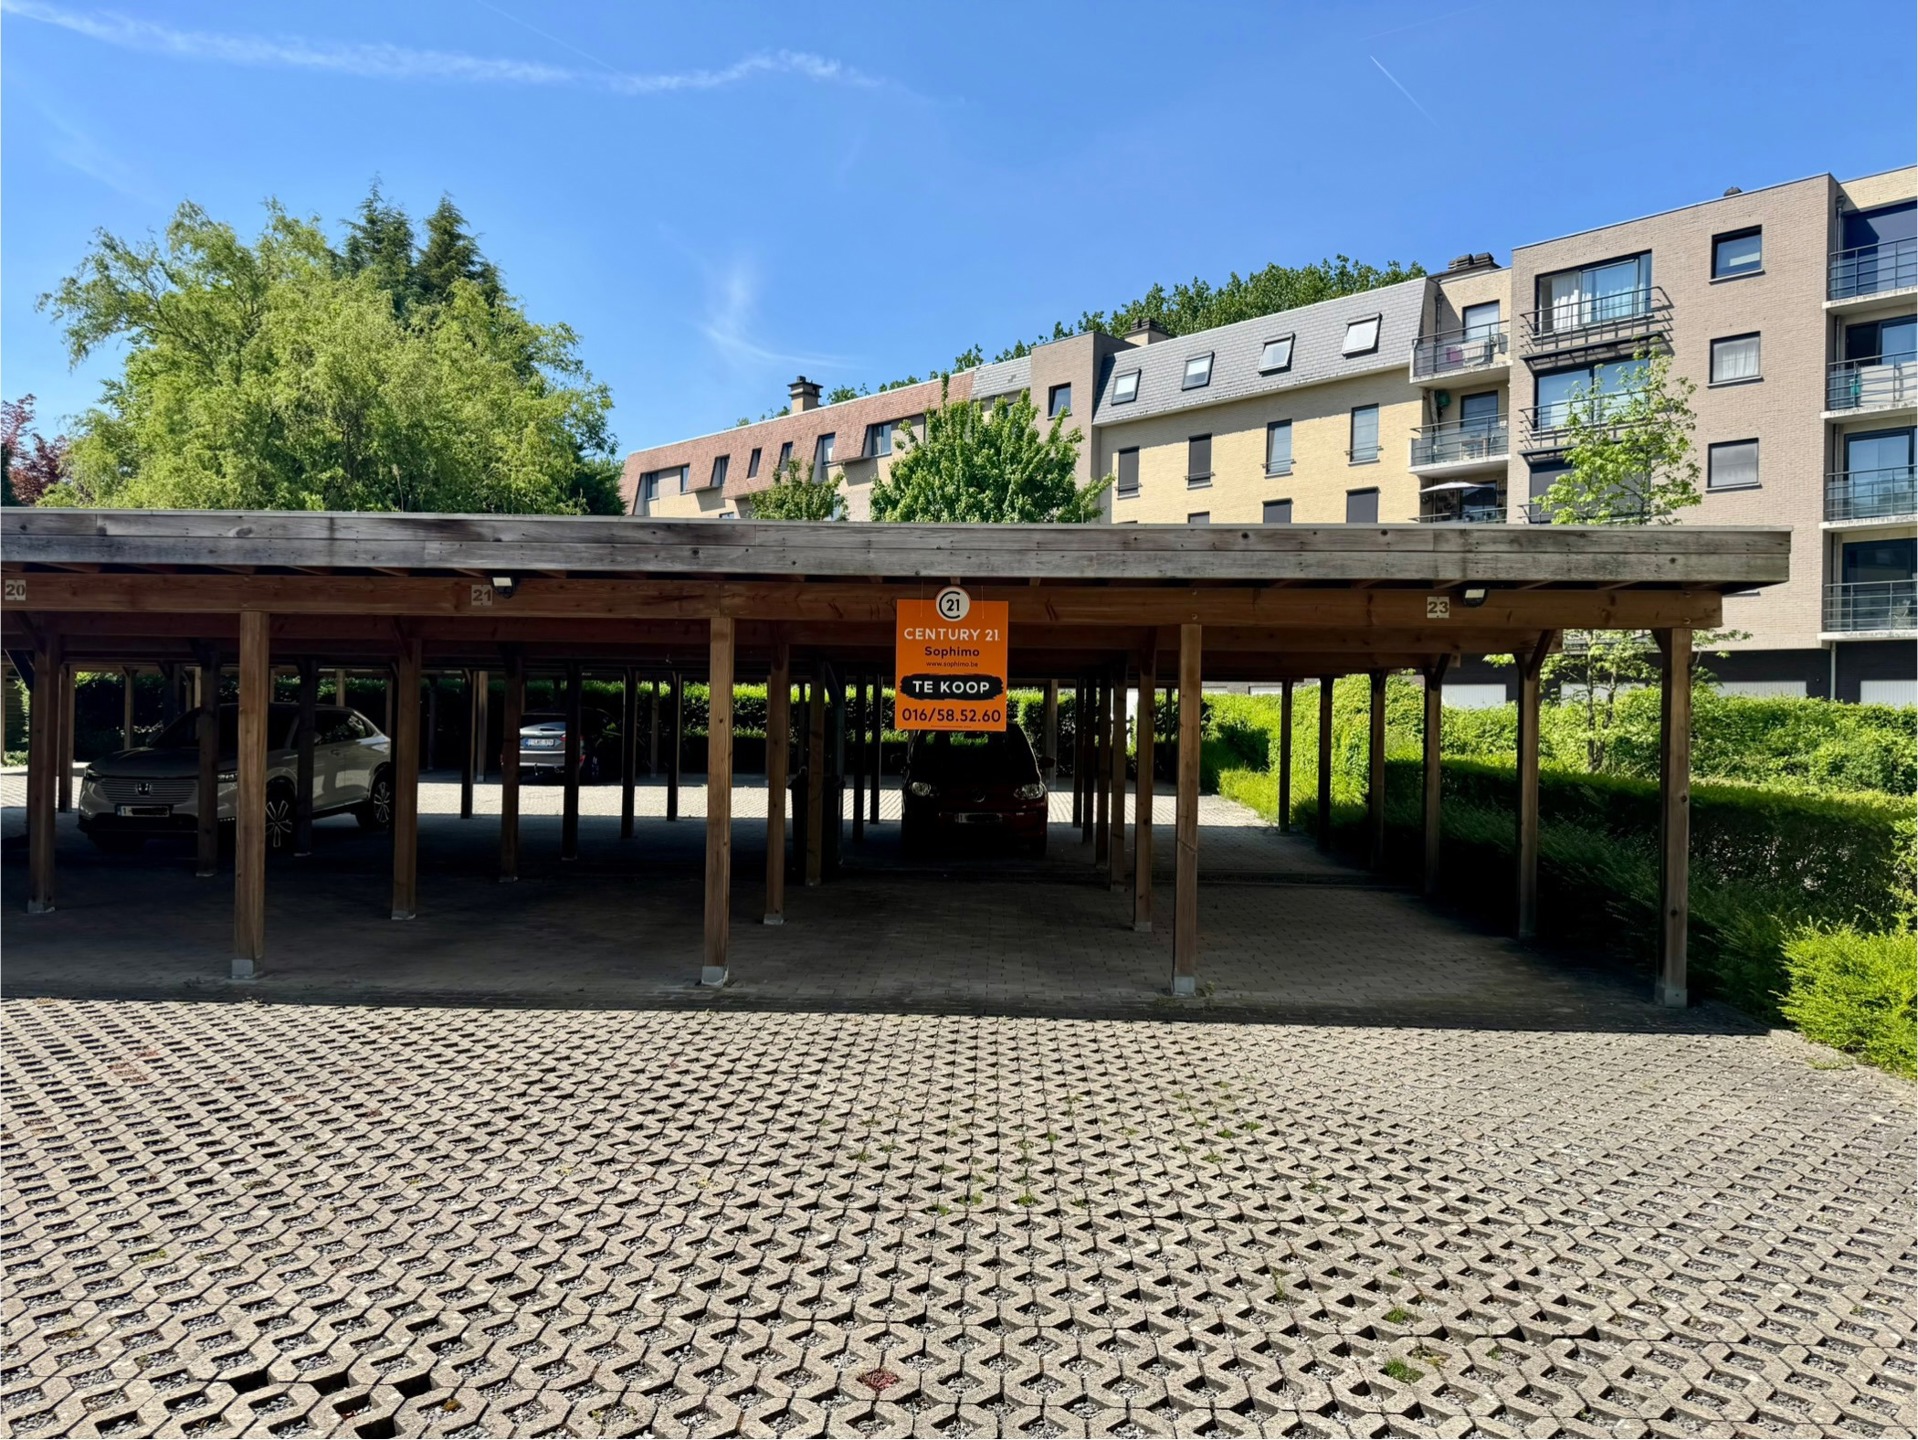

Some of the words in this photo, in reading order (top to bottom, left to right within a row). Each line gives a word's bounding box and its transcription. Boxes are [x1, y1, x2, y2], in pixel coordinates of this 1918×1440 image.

[6, 584, 26, 596] 20
[472, 589, 492, 602] 21
[946, 598, 960, 612] 21
[1427, 601, 1449, 614] 23
[904, 628, 980, 641] CENTURY
[924, 646, 980, 659] Sophimo
[926, 660, 979, 668] www.sophimo.be
[912, 680, 933, 693] TE
[940, 681, 990, 694] KOOP
[901, 708, 1001, 723] 016/58.52.60
